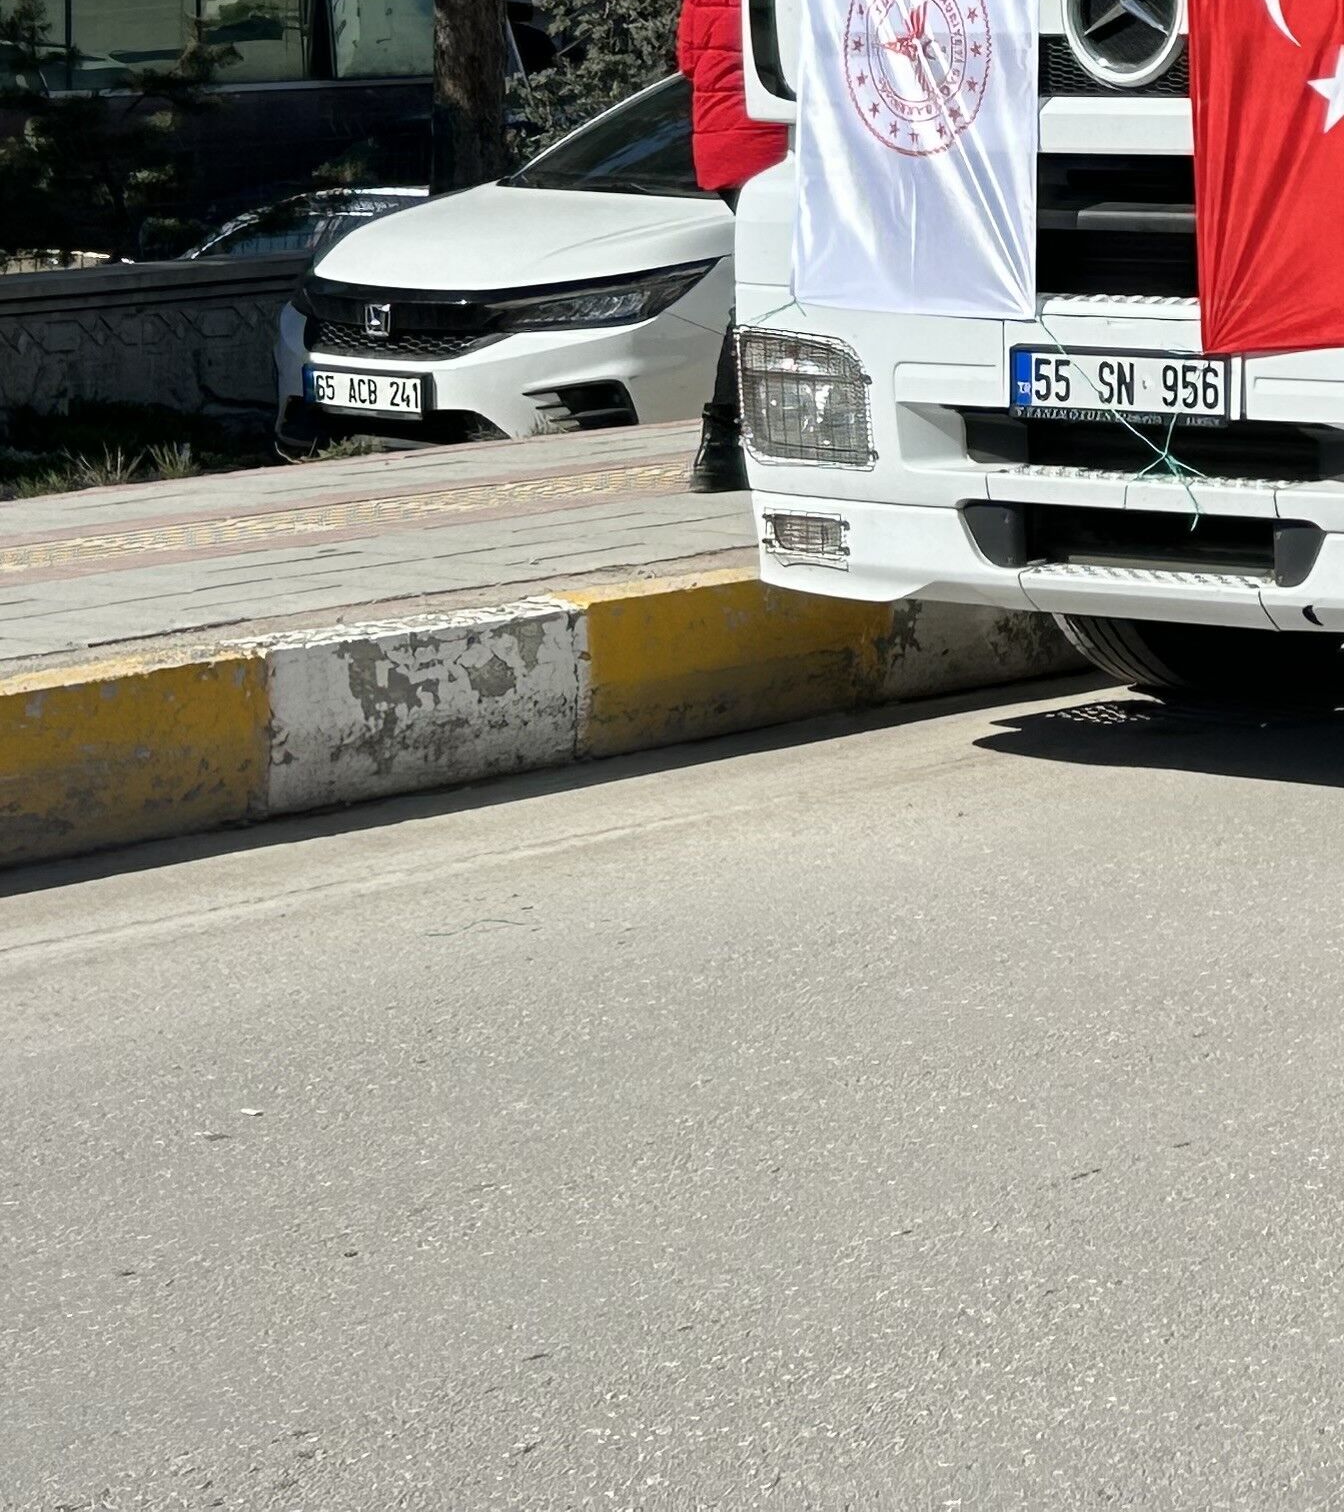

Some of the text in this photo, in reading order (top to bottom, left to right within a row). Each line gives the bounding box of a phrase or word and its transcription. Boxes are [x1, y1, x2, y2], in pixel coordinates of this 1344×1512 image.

[315, 374, 419, 408] 65 ACB 241
[1034, 357, 1071, 402] 55
[1098, 361, 1135, 405] SN
[1161, 361, 1219, 409] 956
